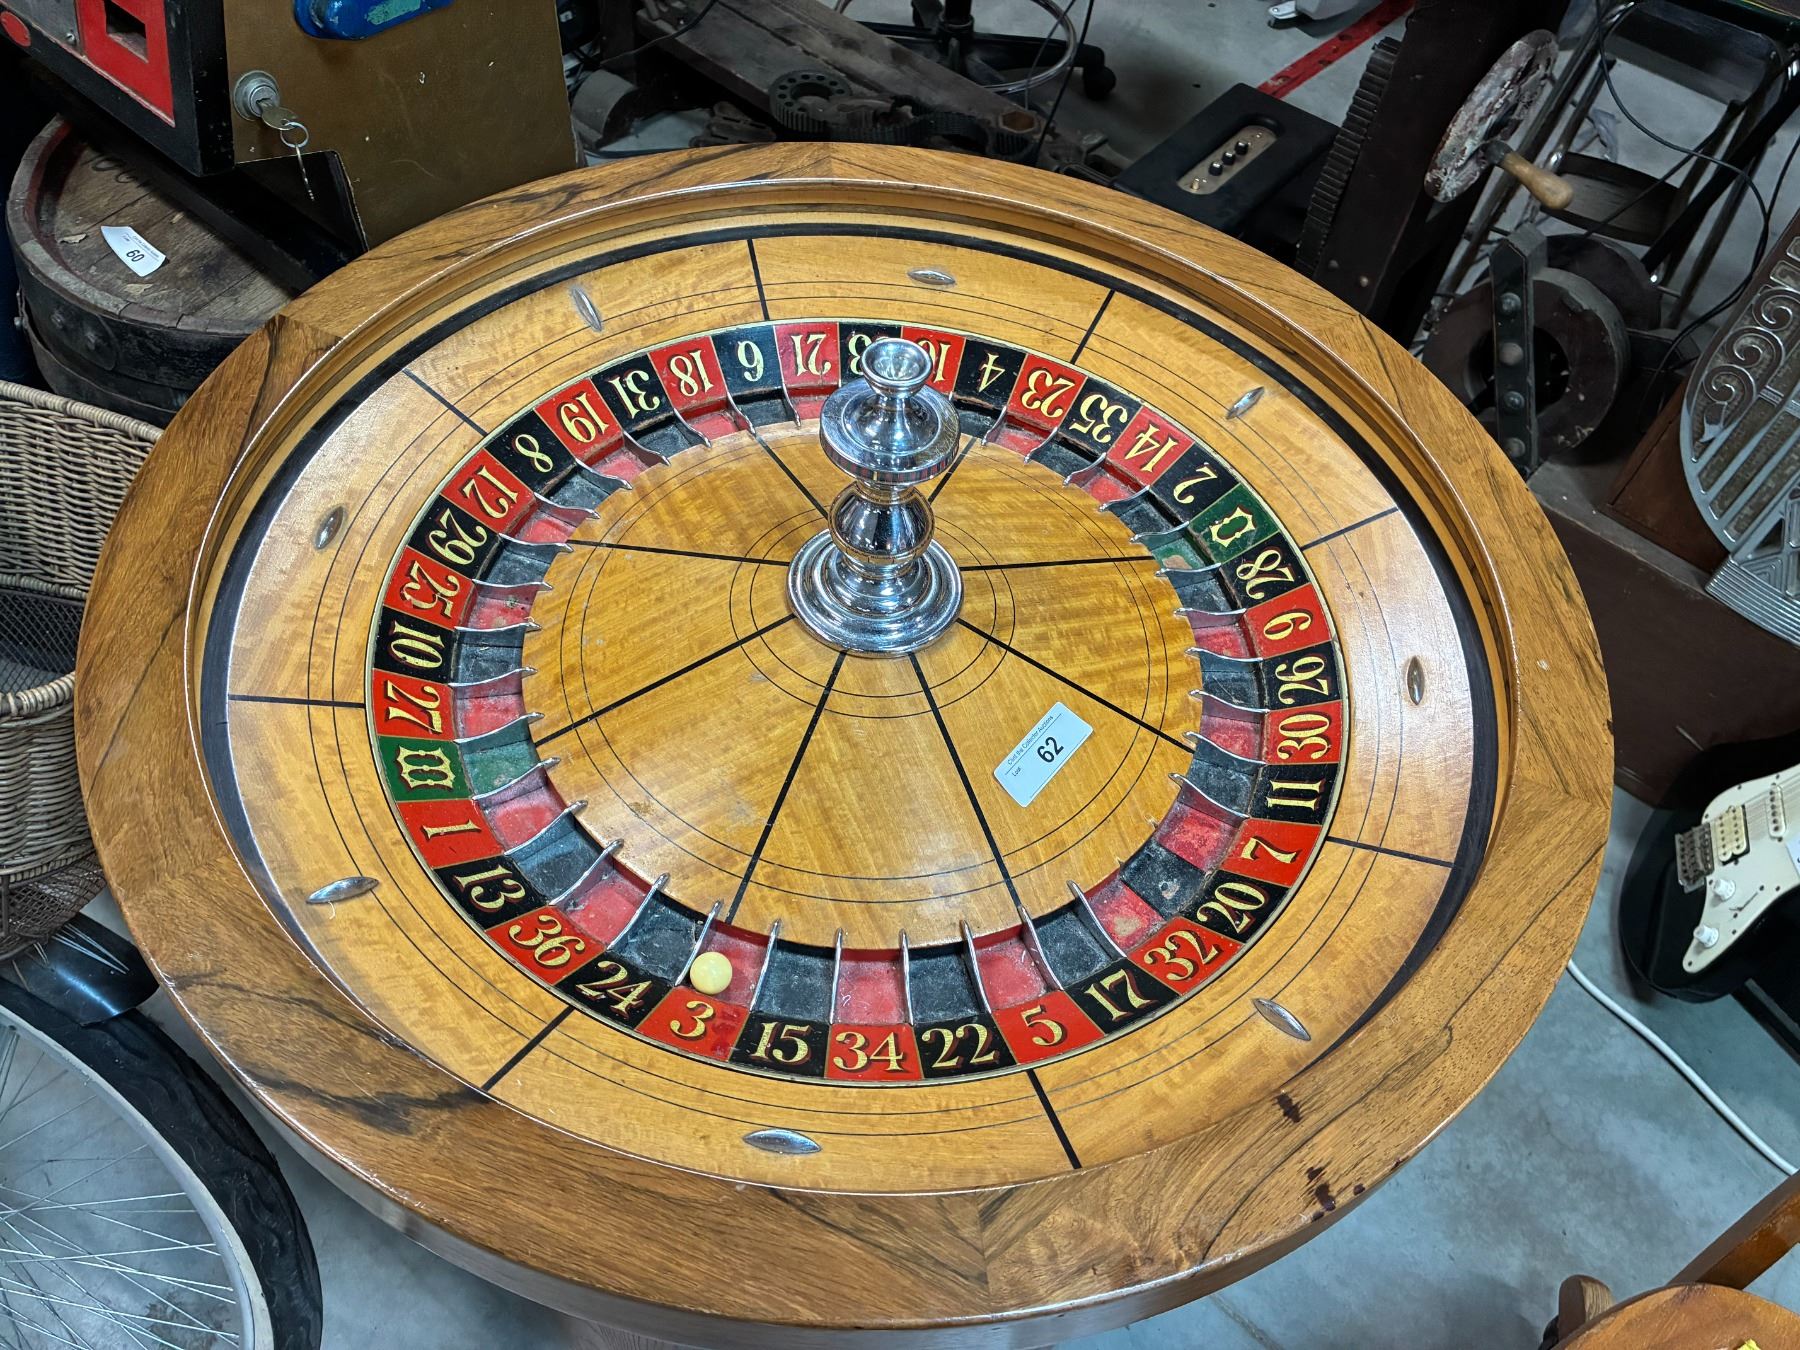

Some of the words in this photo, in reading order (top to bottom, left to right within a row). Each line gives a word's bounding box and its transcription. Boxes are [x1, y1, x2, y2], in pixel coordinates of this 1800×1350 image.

[126, 249, 145, 262] 60
[669, 349, 715, 398] 18
[736, 340, 765, 382] 6
[791, 333, 830, 376] 21
[978, 353, 1006, 392] 4
[612, 370, 661, 419] 31
[1021, 368, 1076, 419] 23
[560, 392, 611, 444] 19
[1070, 394, 1129, 444] 35
[514, 433, 554, 473] 8
[1123, 417, 1179, 473] 14
[463, 464, 520, 519] 12
[1174, 465, 1218, 504] 2
[428, 507, 488, 566] 29
[1210, 506, 1257, 549] 0
[401, 560, 460, 618] 25
[1236, 549, 1295, 600] 28
[388, 622, 444, 669] 10
[1263, 609, 1313, 641] 9
[1275, 655, 1331, 706] 26
[387, 680, 442, 735] 27
[1037, 715, 1054, 733] Auctions
[1037, 736, 1064, 763] 62
[1277, 712, 1331, 760] 30
[1267, 778, 1323, 811] 11
[422, 818, 480, 840] 1
[1241, 836, 1300, 864] 7
[453, 866, 527, 910] 13
[1197, 882, 1266, 930] 20
[508, 914, 585, 966] 36
[1144, 929, 1219, 982] 32
[576, 960, 652, 1018] 24
[1084, 968, 1140, 1021] 17
[670, 1000, 715, 1038] 3
[756, 1020, 810, 1063] 15
[1020, 1004, 1064, 1047] 5
[833, 1030, 904, 1073] 34
[921, 1022, 998, 1070] 22
